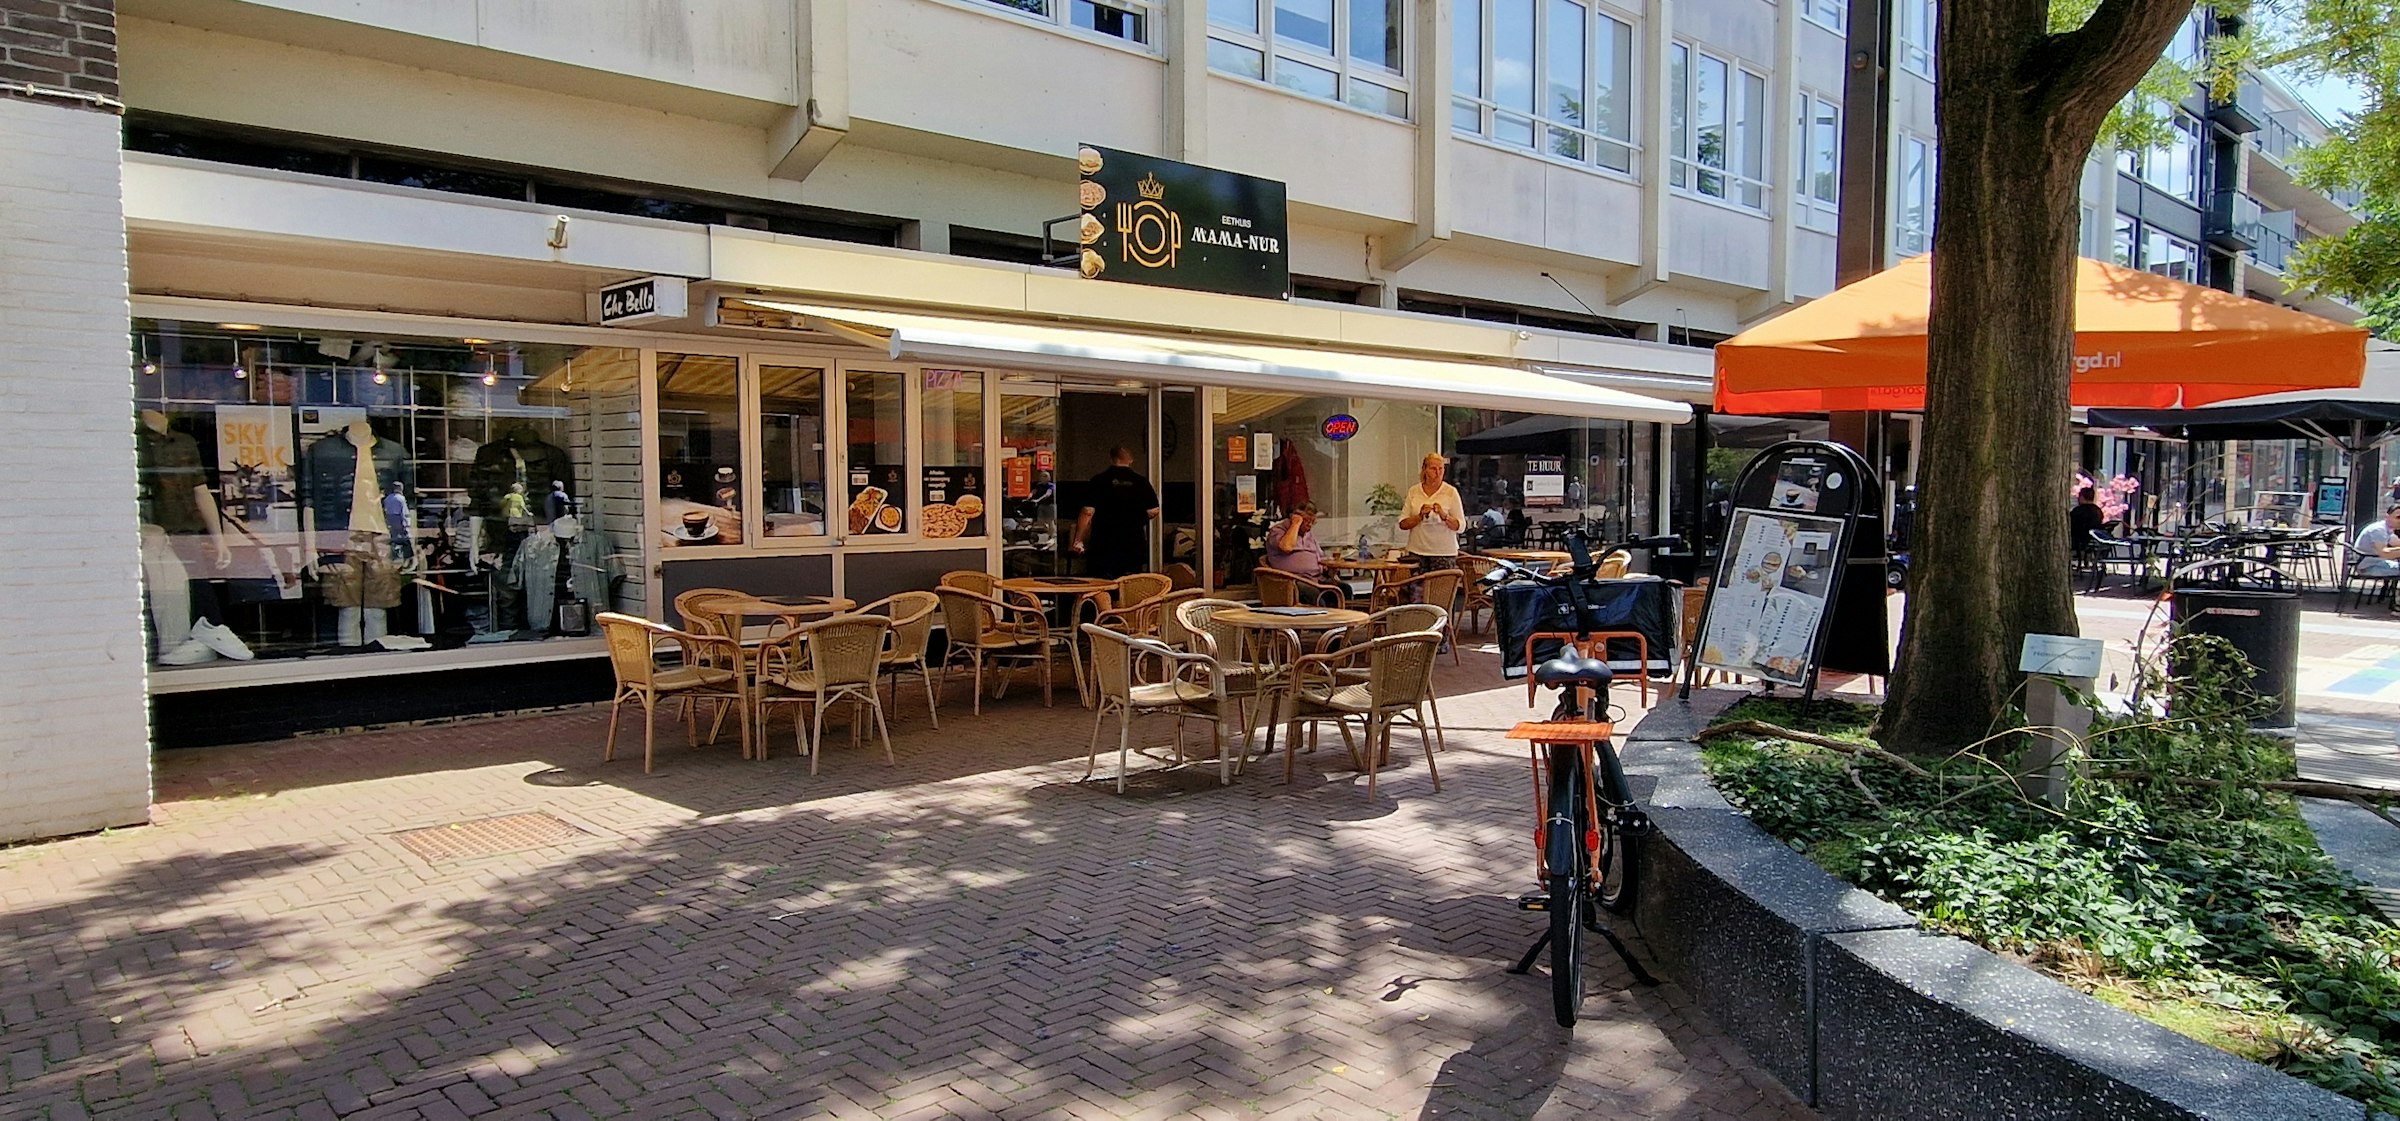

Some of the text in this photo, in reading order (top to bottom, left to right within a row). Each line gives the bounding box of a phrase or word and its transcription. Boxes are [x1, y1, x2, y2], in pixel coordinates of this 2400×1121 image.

[1221, 214, 1251, 229] EETHUIS
[1191, 226, 1280, 254] MAMA-NUR
[926, 370, 963, 390] PIZZA
[224, 421, 268, 445] SKY
[1325, 420, 1356, 434] OPEN
[1527, 460, 1562, 473] TE HUUR
